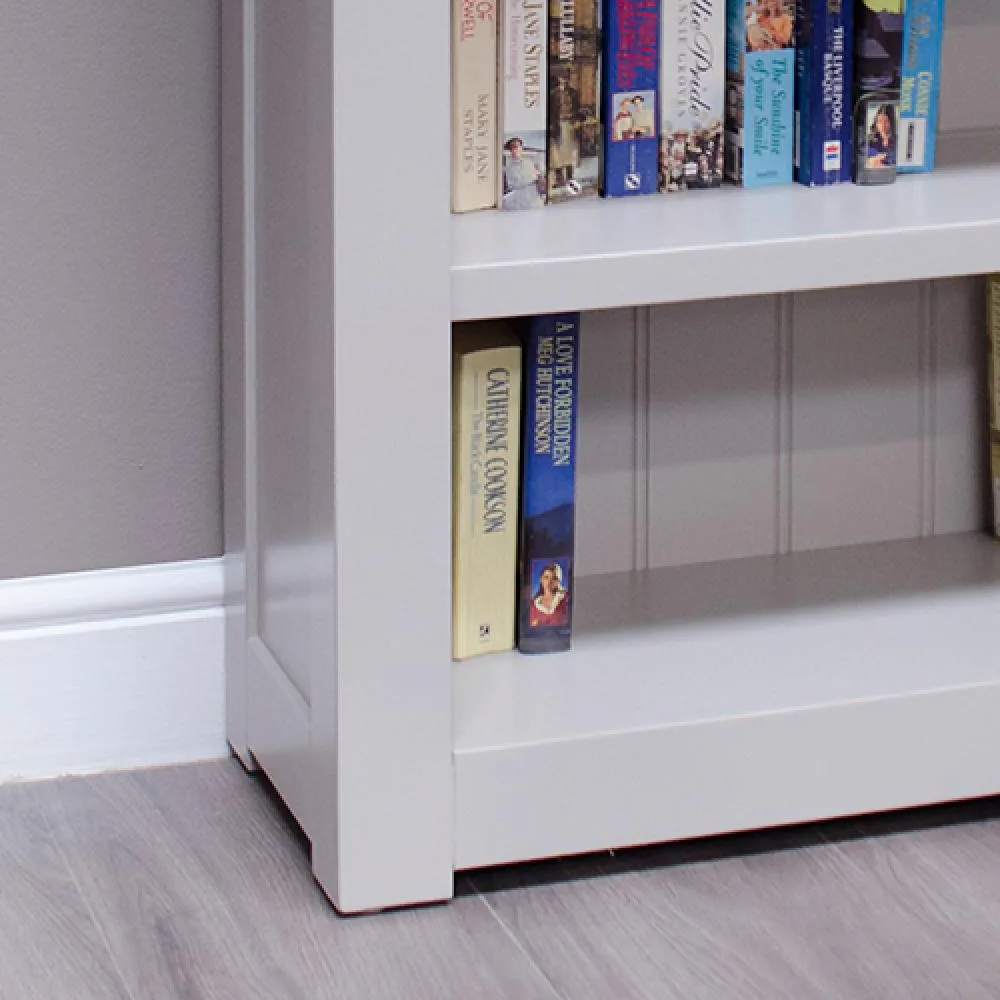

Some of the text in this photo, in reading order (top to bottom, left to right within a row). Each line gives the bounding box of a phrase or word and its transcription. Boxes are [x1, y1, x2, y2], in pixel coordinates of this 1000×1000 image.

[477, 1, 494, 22] OF
[521, 0, 544, 40] JANE
[522, 43, 544, 109] STAPLES
[676, 52, 689, 119] GROVES
[685, 33, 715, 121] Pride
[750, 58, 769, 157] of your Smile
[769, 57, 788, 157] The Sunshine
[831, 27, 844, 128] THE LIVERPOOL
[462, 108, 475, 173] STAPLES
[477, 94, 490, 185] MARY JANE
[534, 335, 553, 455] MEG HUTCHINSON
[551, 321, 575, 467] A LOVE FORBIDDEN
[482, 367, 511, 535] CATHERINE COOKSON
